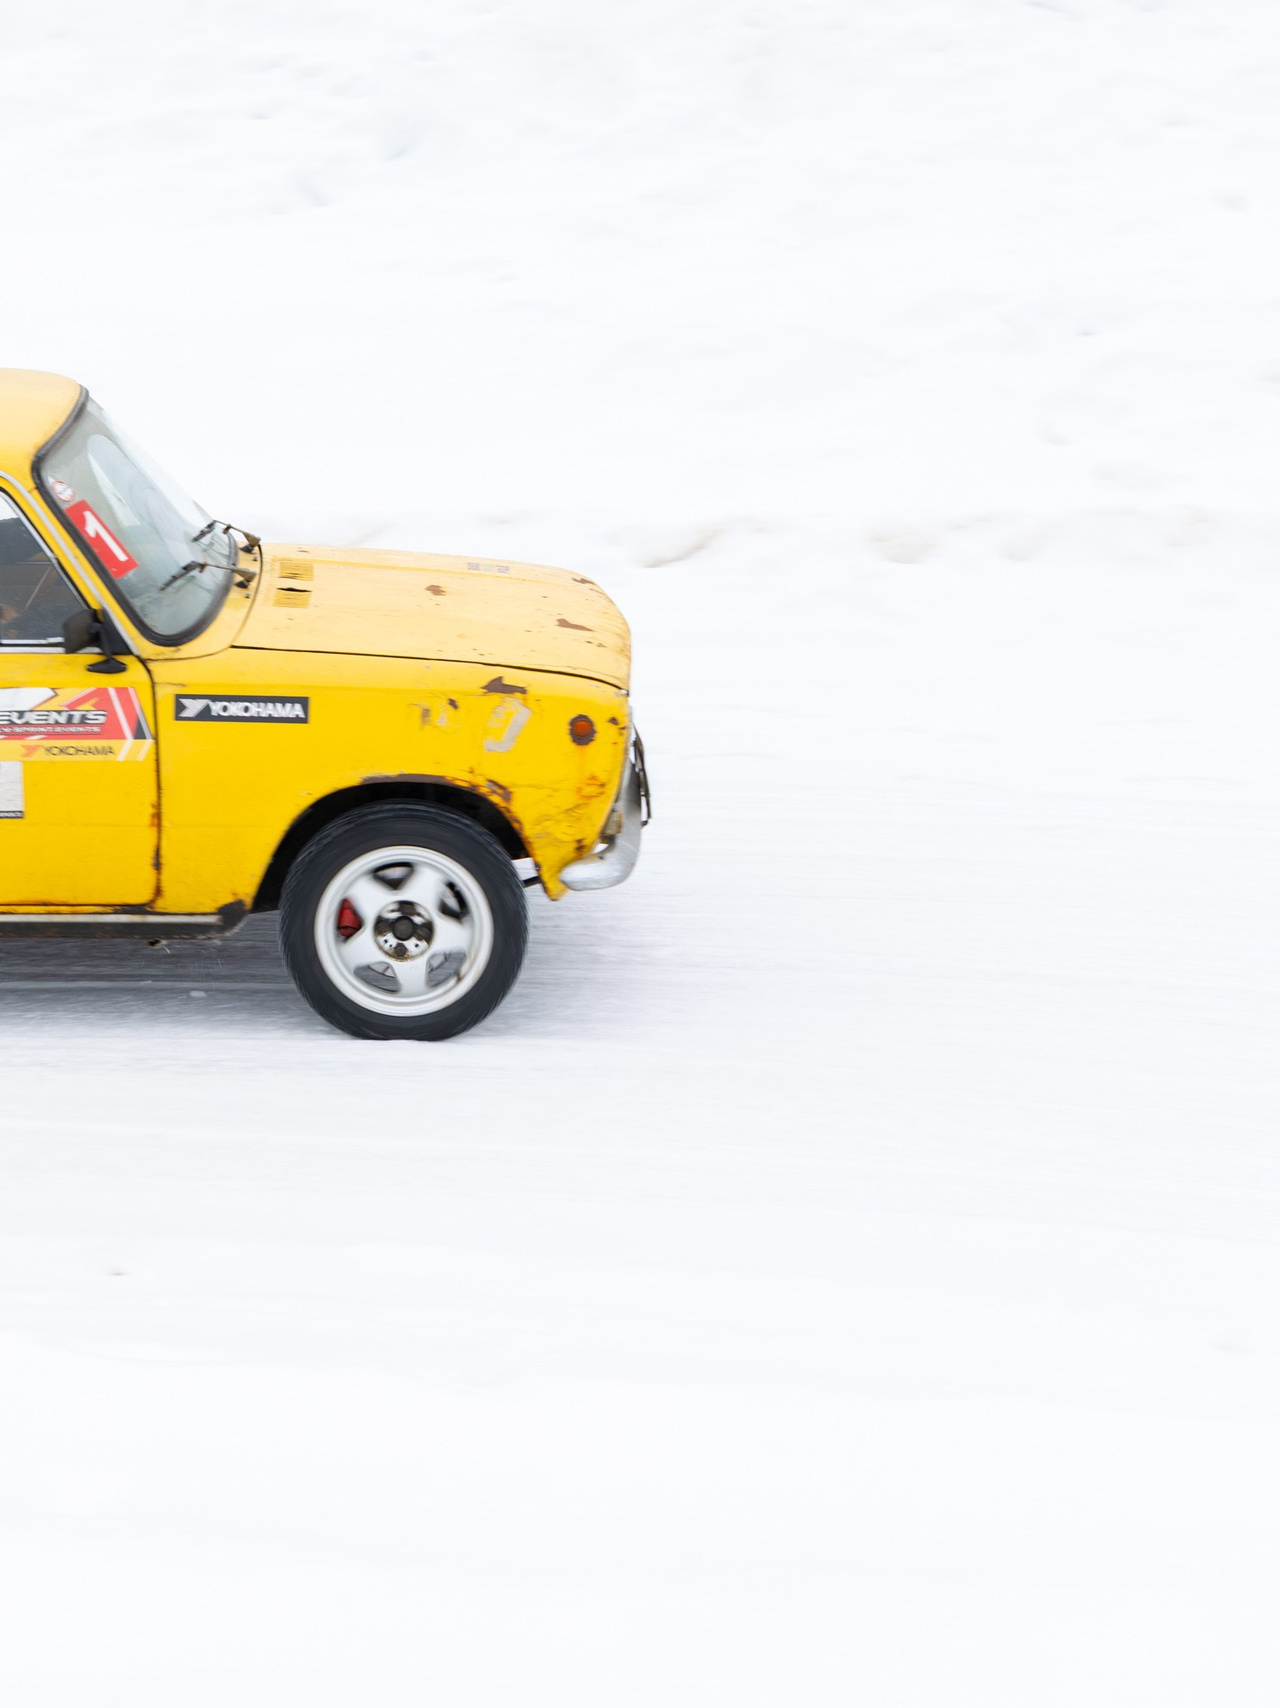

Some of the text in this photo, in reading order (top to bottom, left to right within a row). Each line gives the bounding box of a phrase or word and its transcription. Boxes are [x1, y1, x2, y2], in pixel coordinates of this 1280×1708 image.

[82, 510, 130, 562] 1
[208, 701, 306, 718] YOKOHAMA
[45, 745, 116, 757] YOKOHAMA
